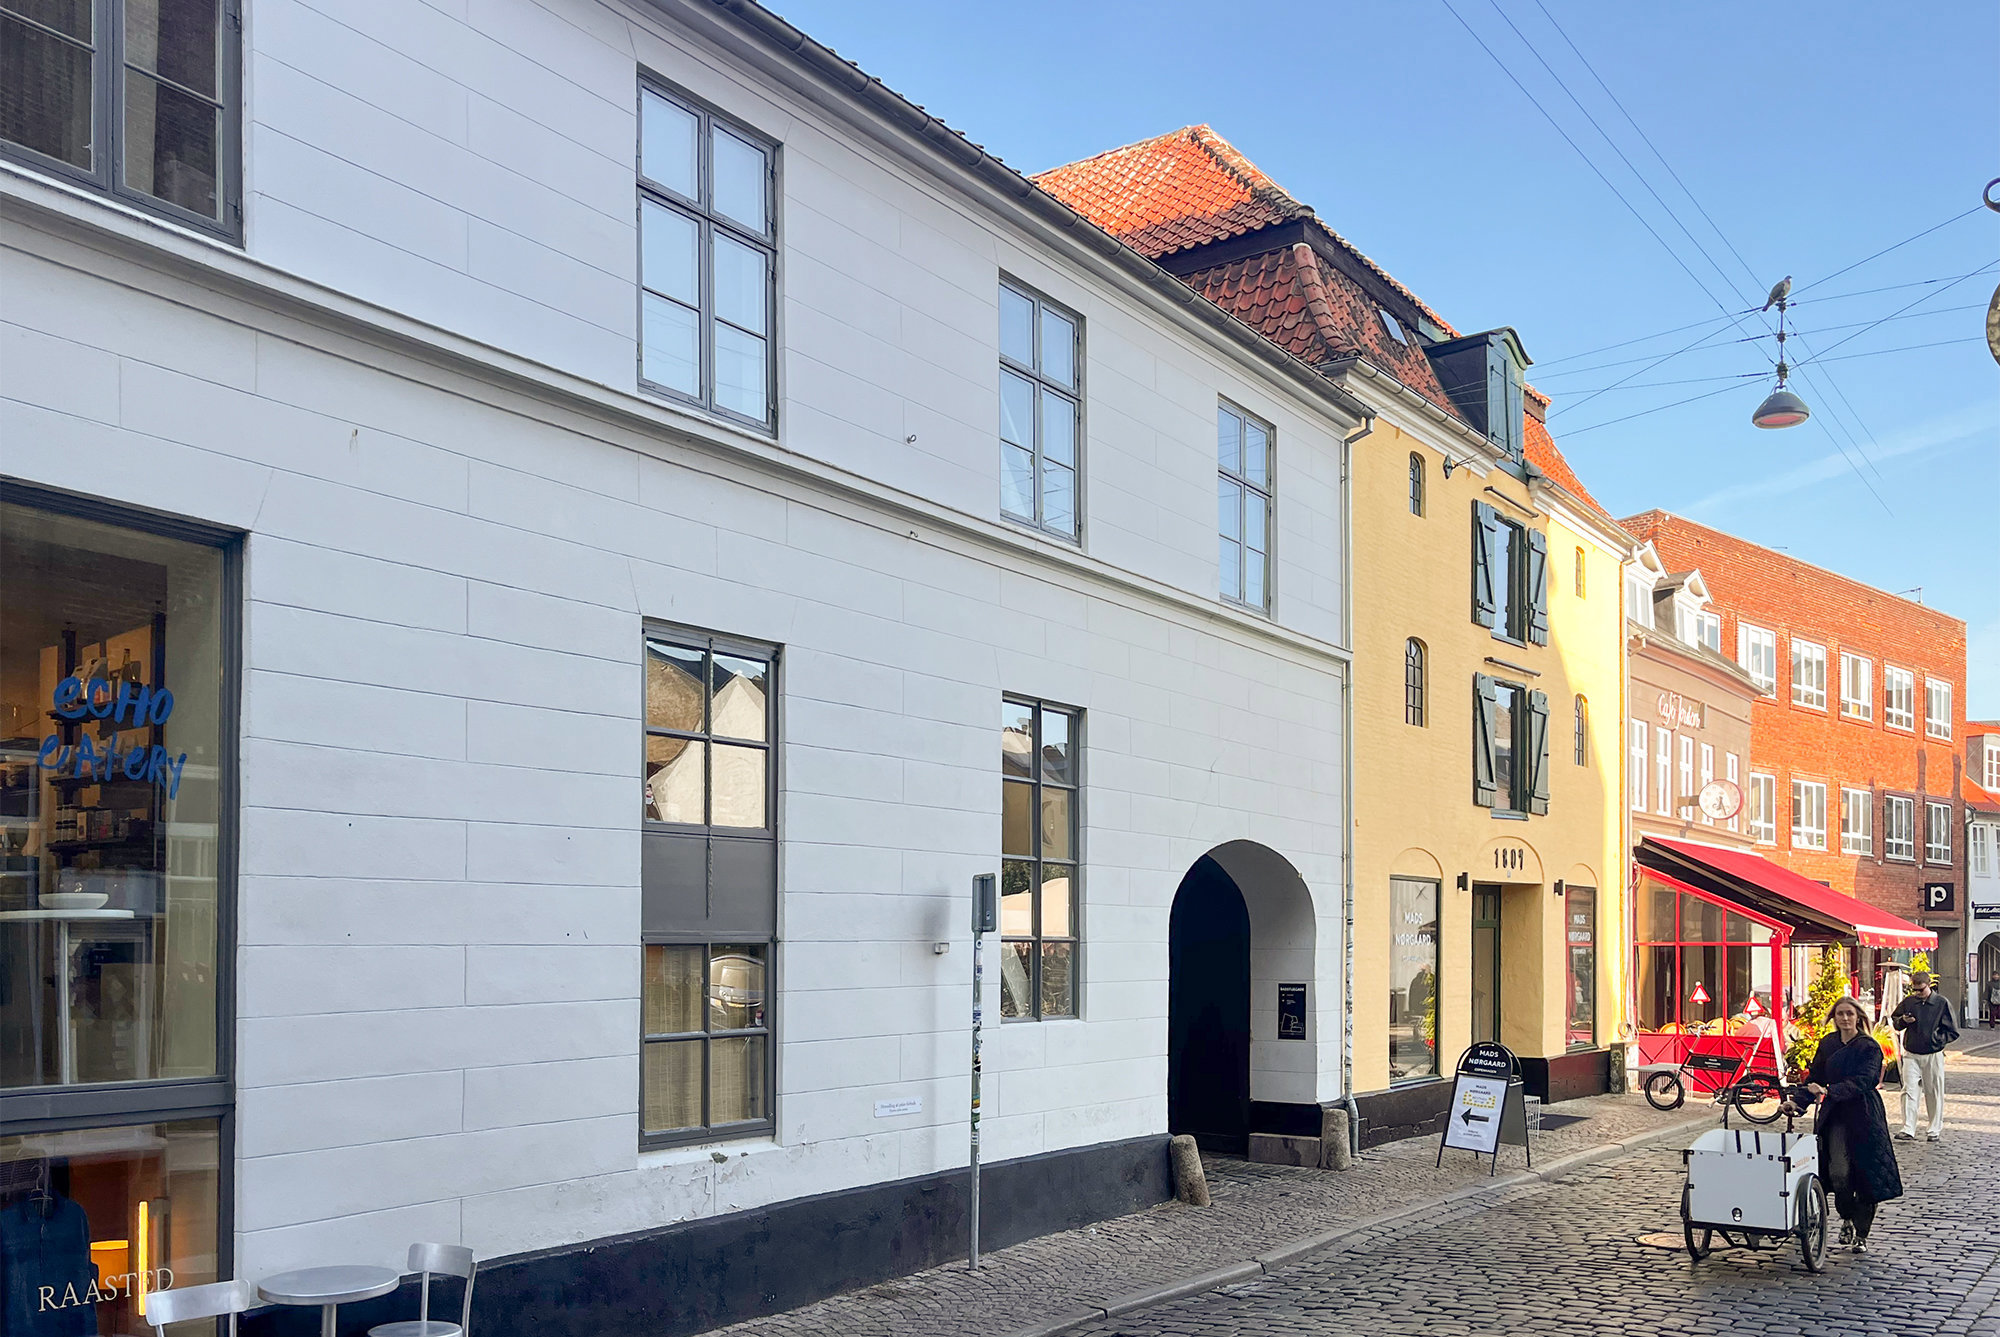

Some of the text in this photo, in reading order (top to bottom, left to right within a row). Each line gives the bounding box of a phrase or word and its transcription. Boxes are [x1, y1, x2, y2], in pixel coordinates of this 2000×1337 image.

[1404, 911, 1423, 924] MADS
[1469, 1058, 1506, 1068] NØRGAARD
[38, 1268, 175, 1312] RAASTED
